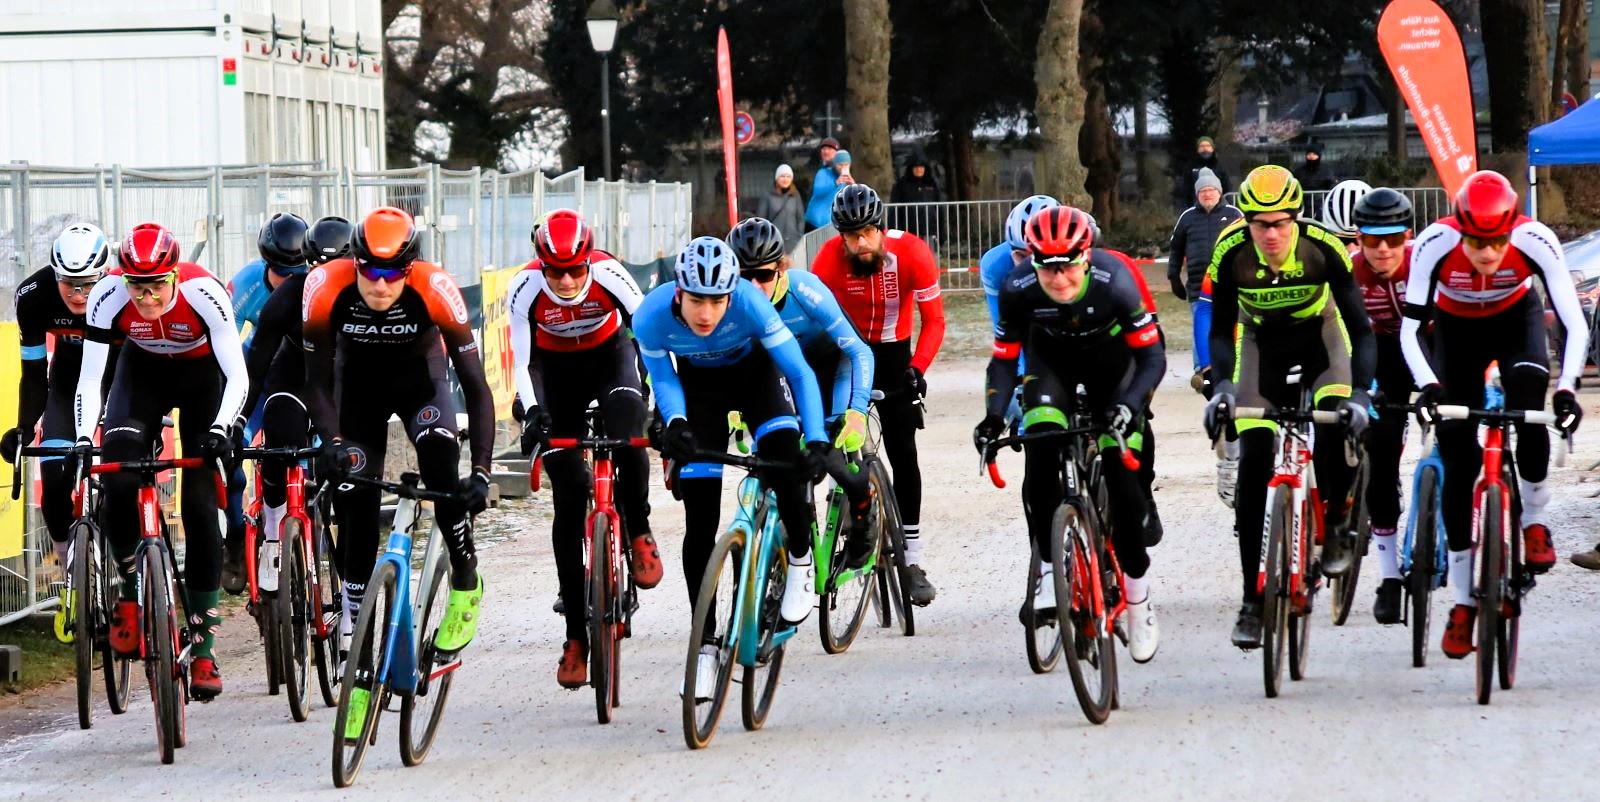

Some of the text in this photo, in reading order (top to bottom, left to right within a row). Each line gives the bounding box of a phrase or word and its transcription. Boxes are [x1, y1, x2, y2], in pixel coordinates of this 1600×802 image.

[1526, 231, 1560, 261] STEVENS
[436, 277, 466, 317] ABUS
[604, 267, 638, 297] STEVENS
[884, 271, 898, 299] CYCLO
[1261, 287, 1312, 303] NORDHEIDE
[91, 285, 117, 325] STEVENS
[198, 287, 228, 322] STEVENS
[53, 318, 74, 326] VCV
[342, 323, 418, 335] BEACON
